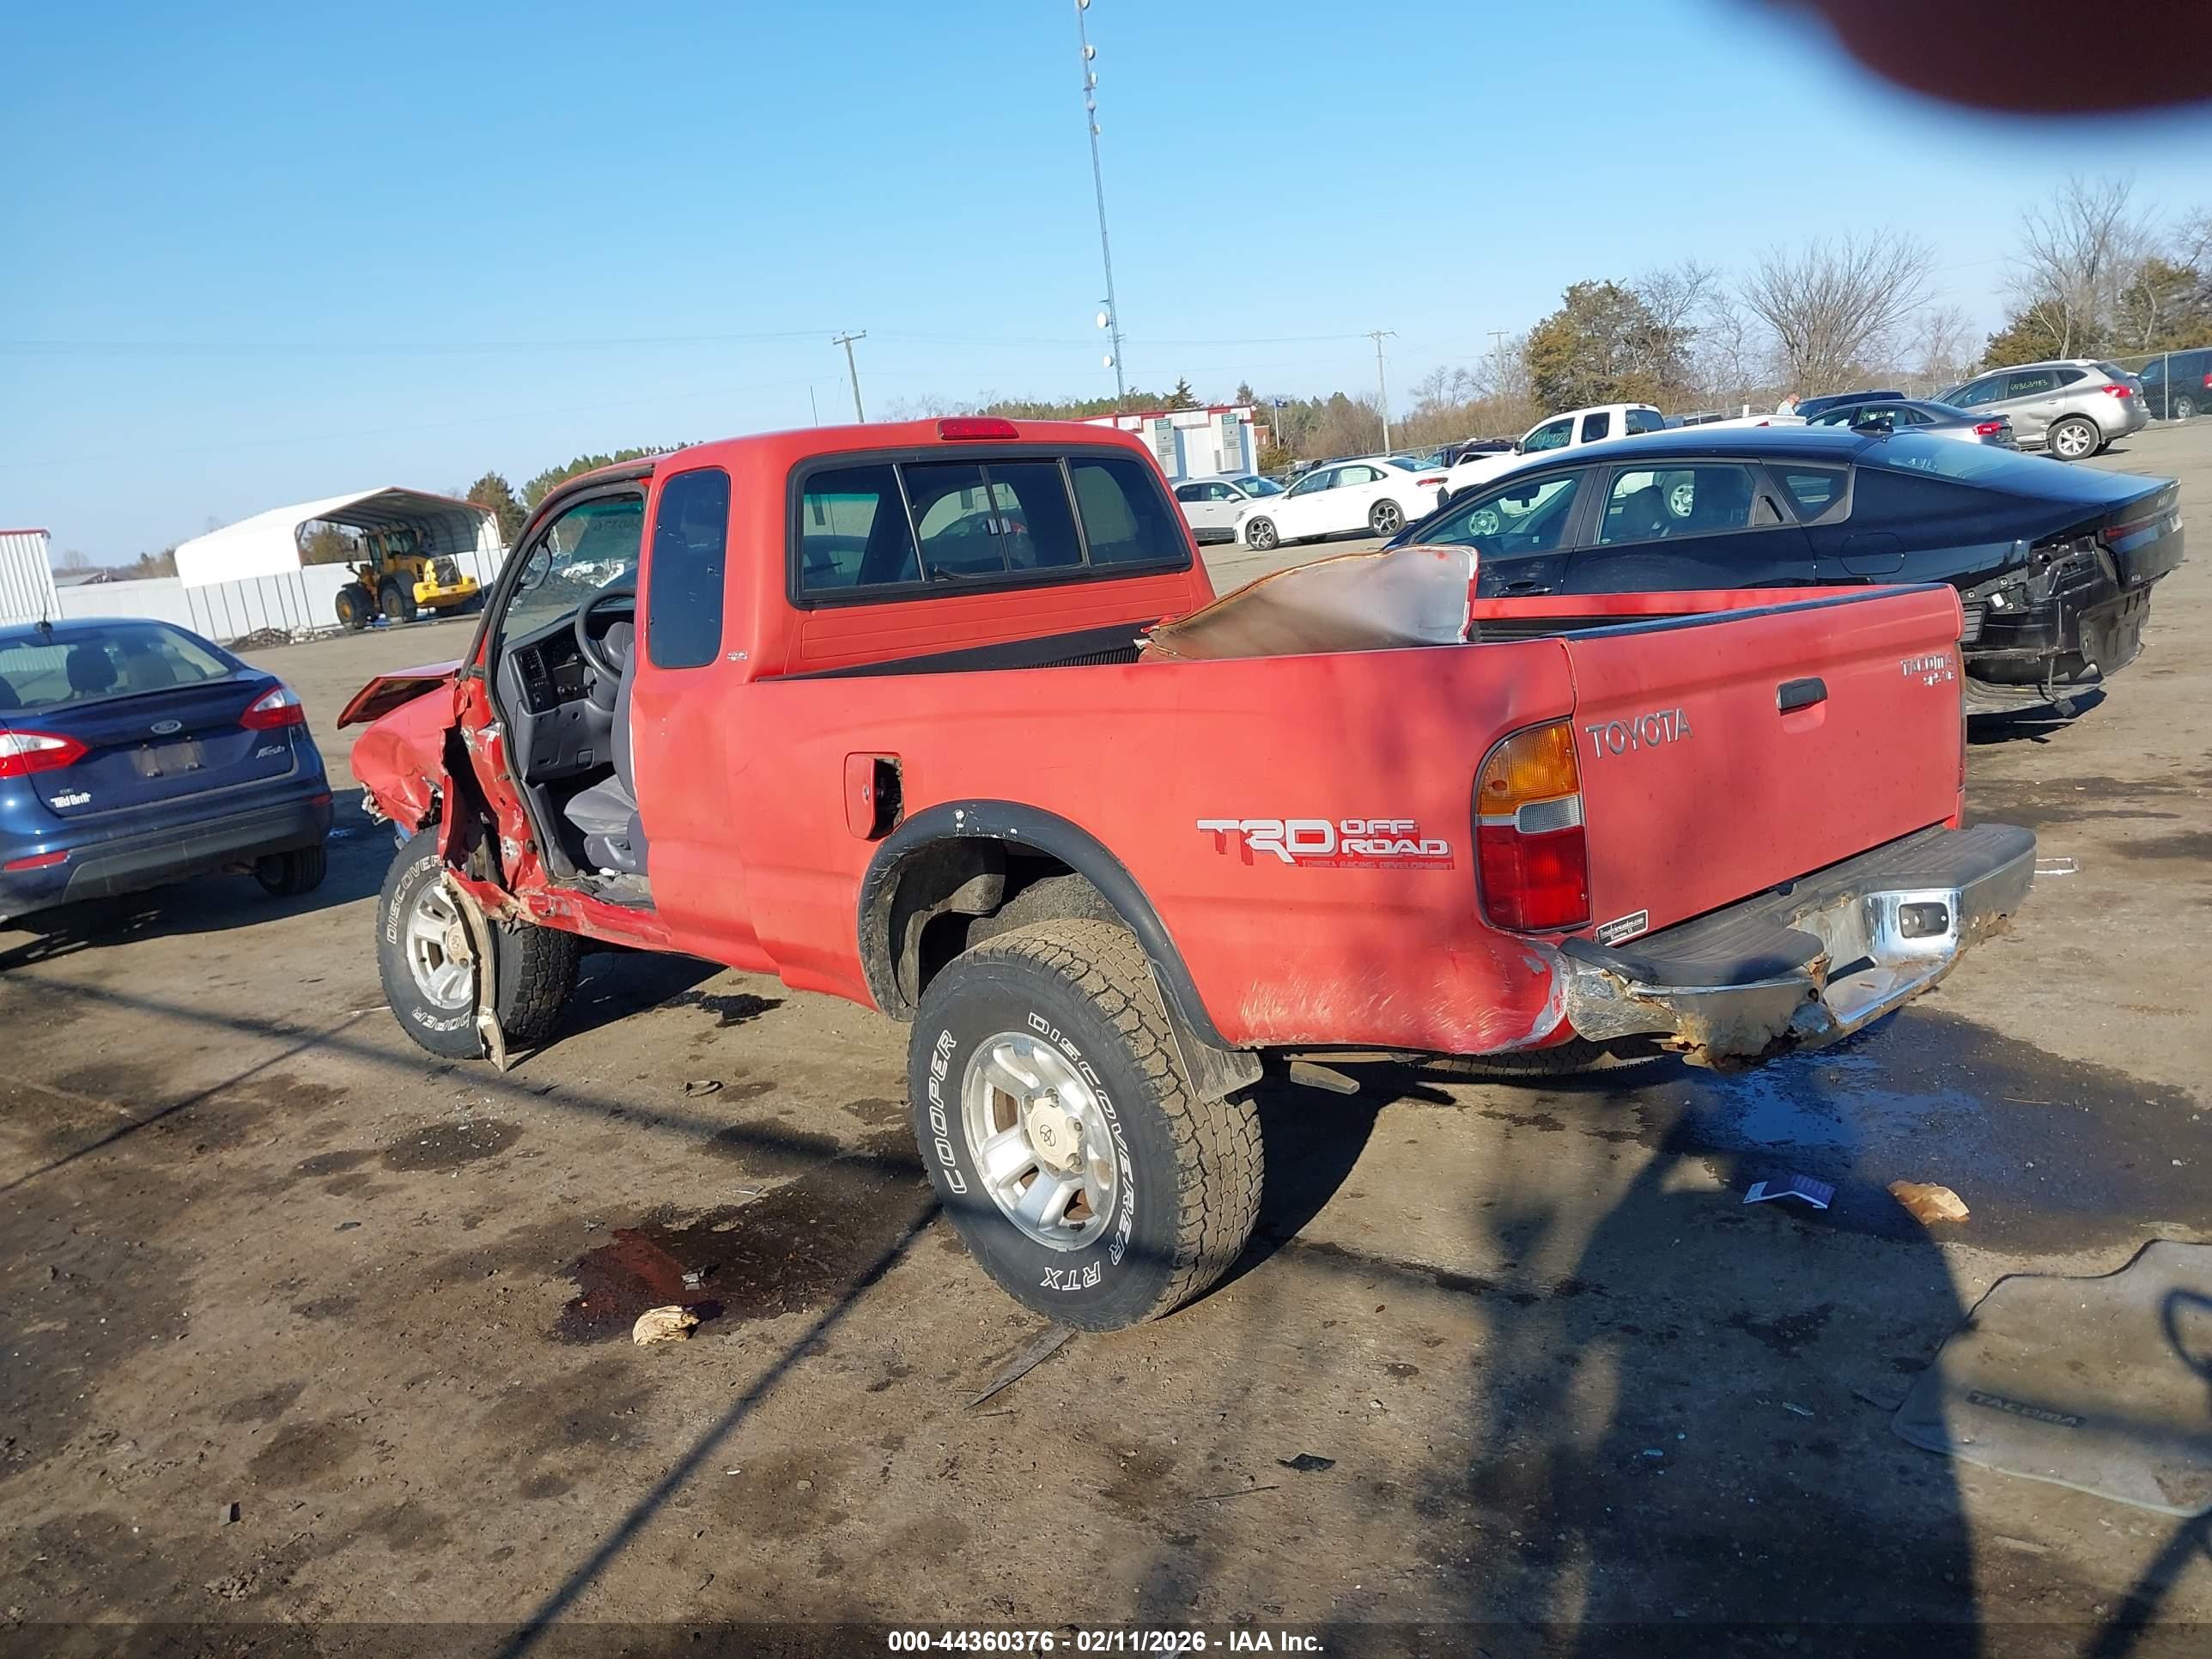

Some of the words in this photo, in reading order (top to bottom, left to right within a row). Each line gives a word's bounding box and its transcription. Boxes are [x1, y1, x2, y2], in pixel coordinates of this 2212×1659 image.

[1585, 708, 1693, 758] TOYOTA
[1196, 818, 1336, 864] TRD
[1340, 818, 1415, 835] OFF
[1340, 838, 1449, 855] ROAD
[927, 1030, 968, 1194] COOPER
[1027, 1012, 1134, 1267] DISCOVERER
[1039, 1260, 1103, 1291] RTX
